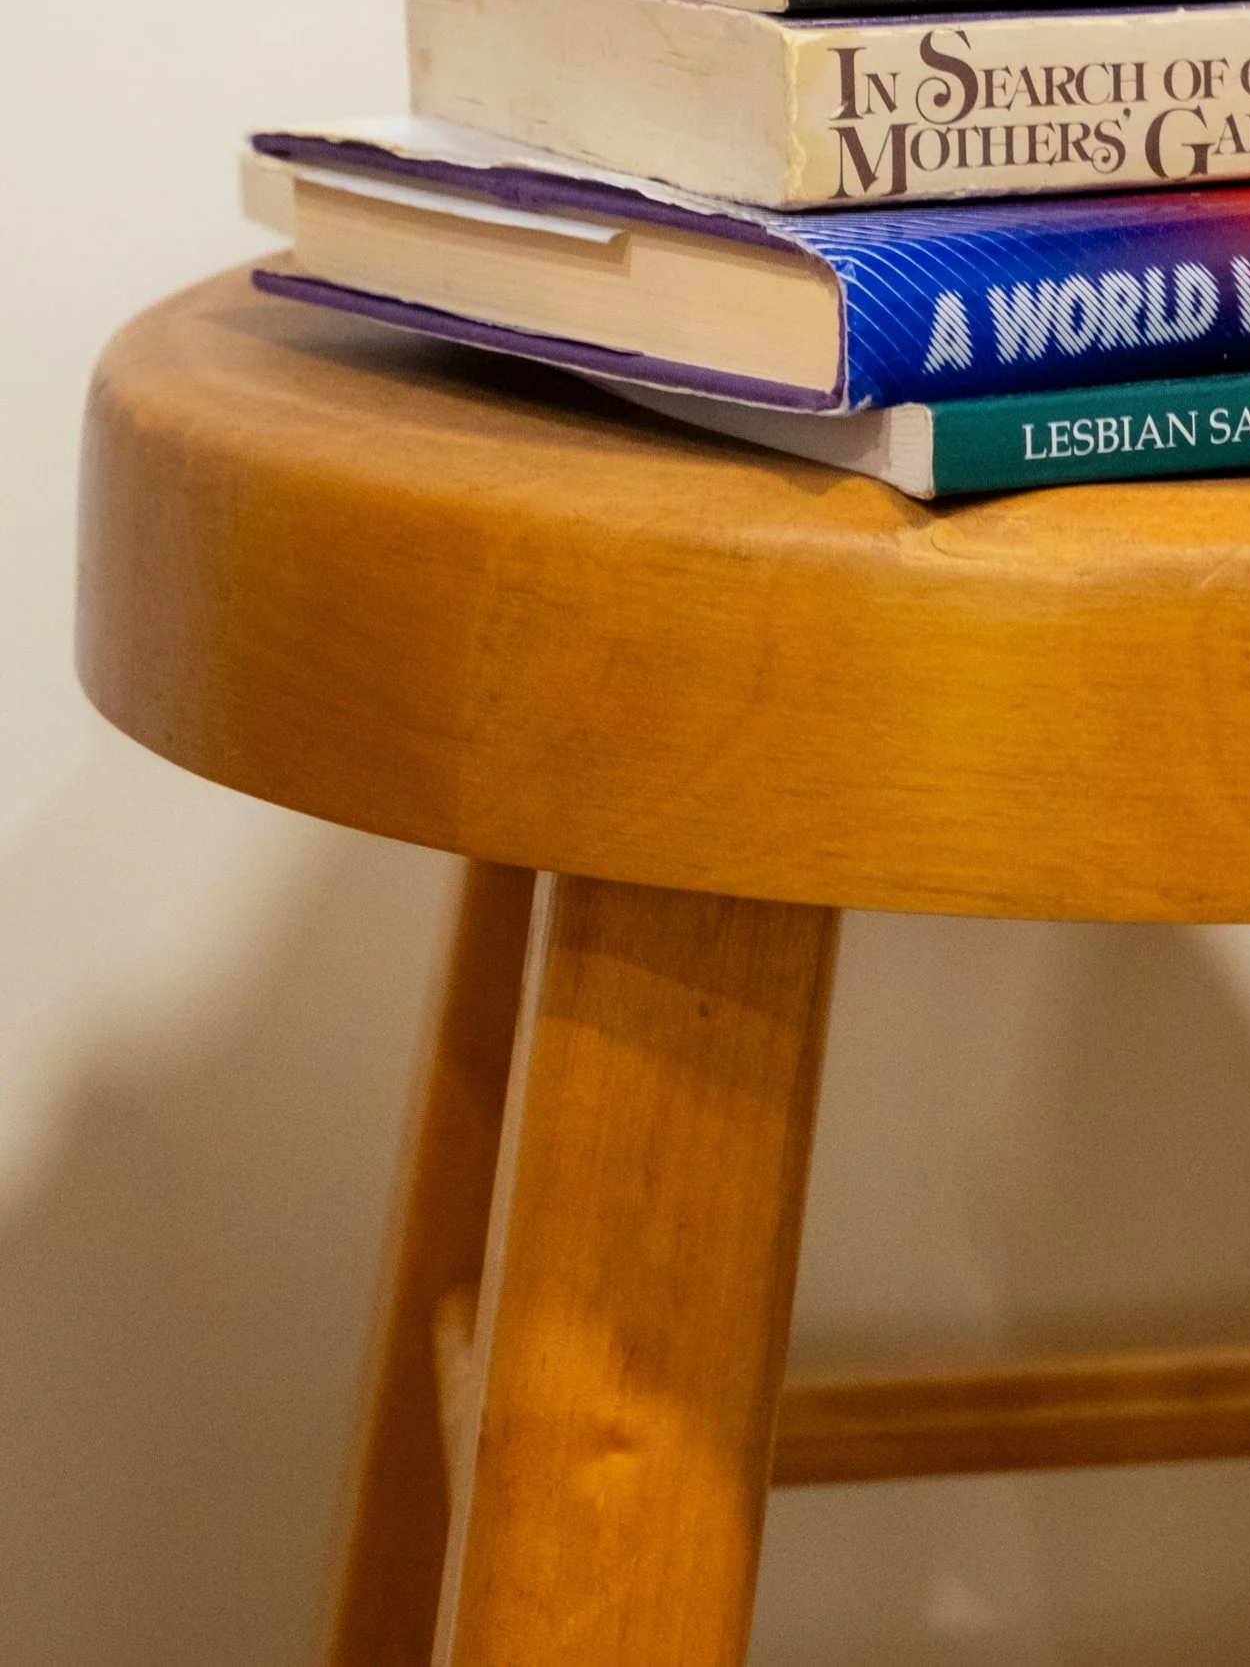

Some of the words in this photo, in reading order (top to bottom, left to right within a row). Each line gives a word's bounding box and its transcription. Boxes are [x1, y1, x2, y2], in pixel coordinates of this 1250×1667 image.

[1162, 58, 1231, 100] OF
[924, 290, 975, 374] A
[986, 263, 1221, 365] WORLD
[1022, 412, 1199, 460] LESBIAN
